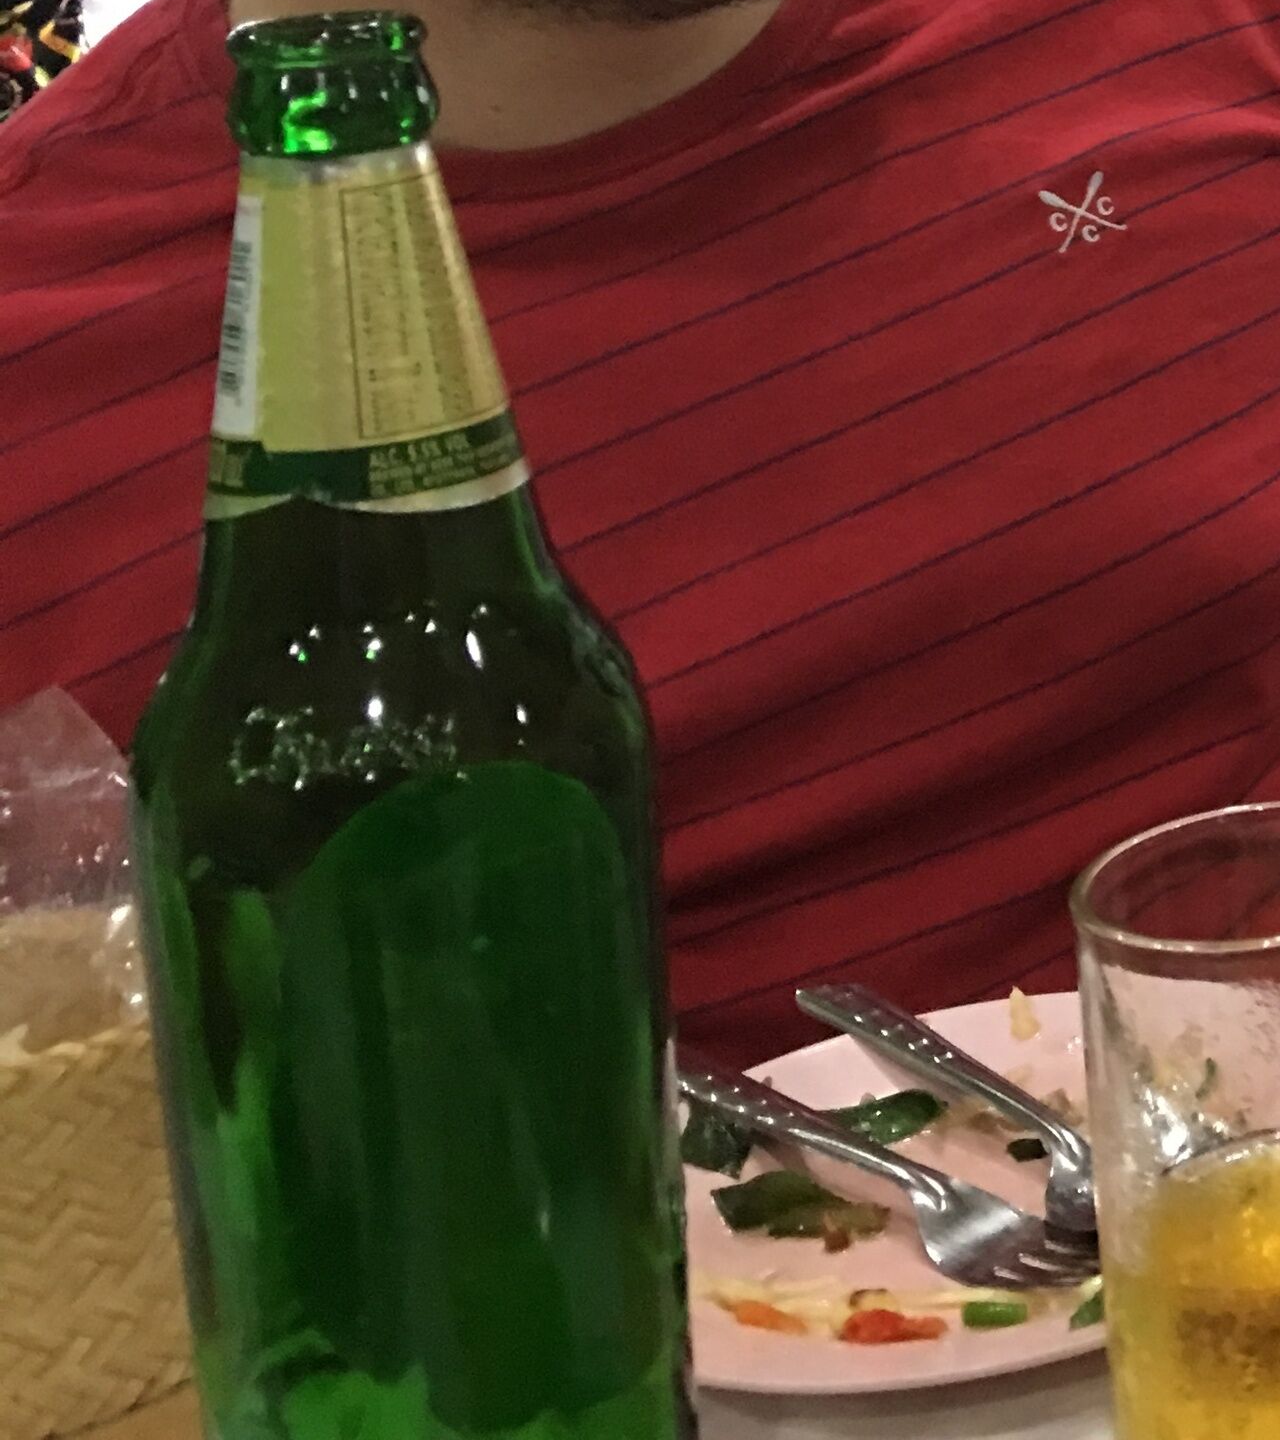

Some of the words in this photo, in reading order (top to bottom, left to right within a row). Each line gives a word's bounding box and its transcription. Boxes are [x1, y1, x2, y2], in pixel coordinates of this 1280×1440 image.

[1096, 196, 1115, 216] C
[1049, 212, 1068, 232] C
[1082, 224, 1100, 242] C
